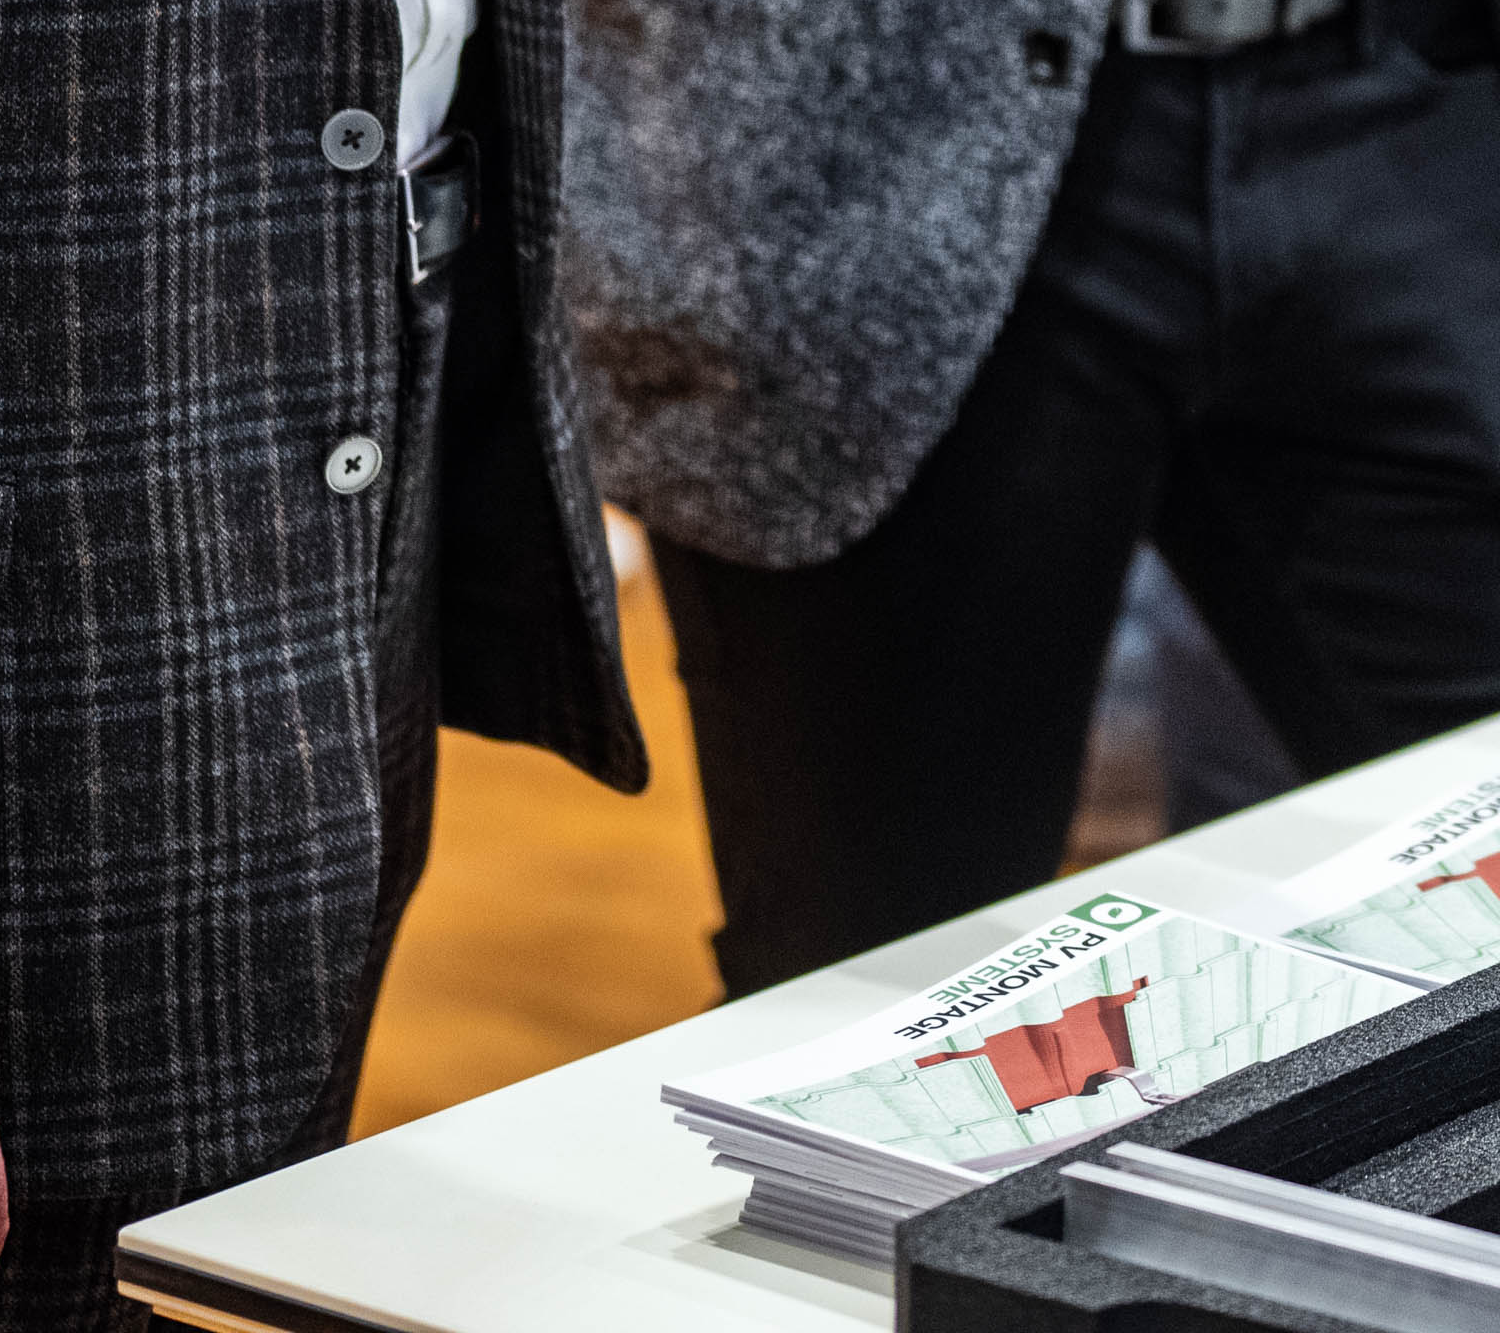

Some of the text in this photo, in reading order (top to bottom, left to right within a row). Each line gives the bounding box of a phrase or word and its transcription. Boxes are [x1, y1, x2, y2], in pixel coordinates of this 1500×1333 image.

[893, 932, 1108, 1040] PV MONTAGE
[927, 924, 1082, 1004] SYSTEME
